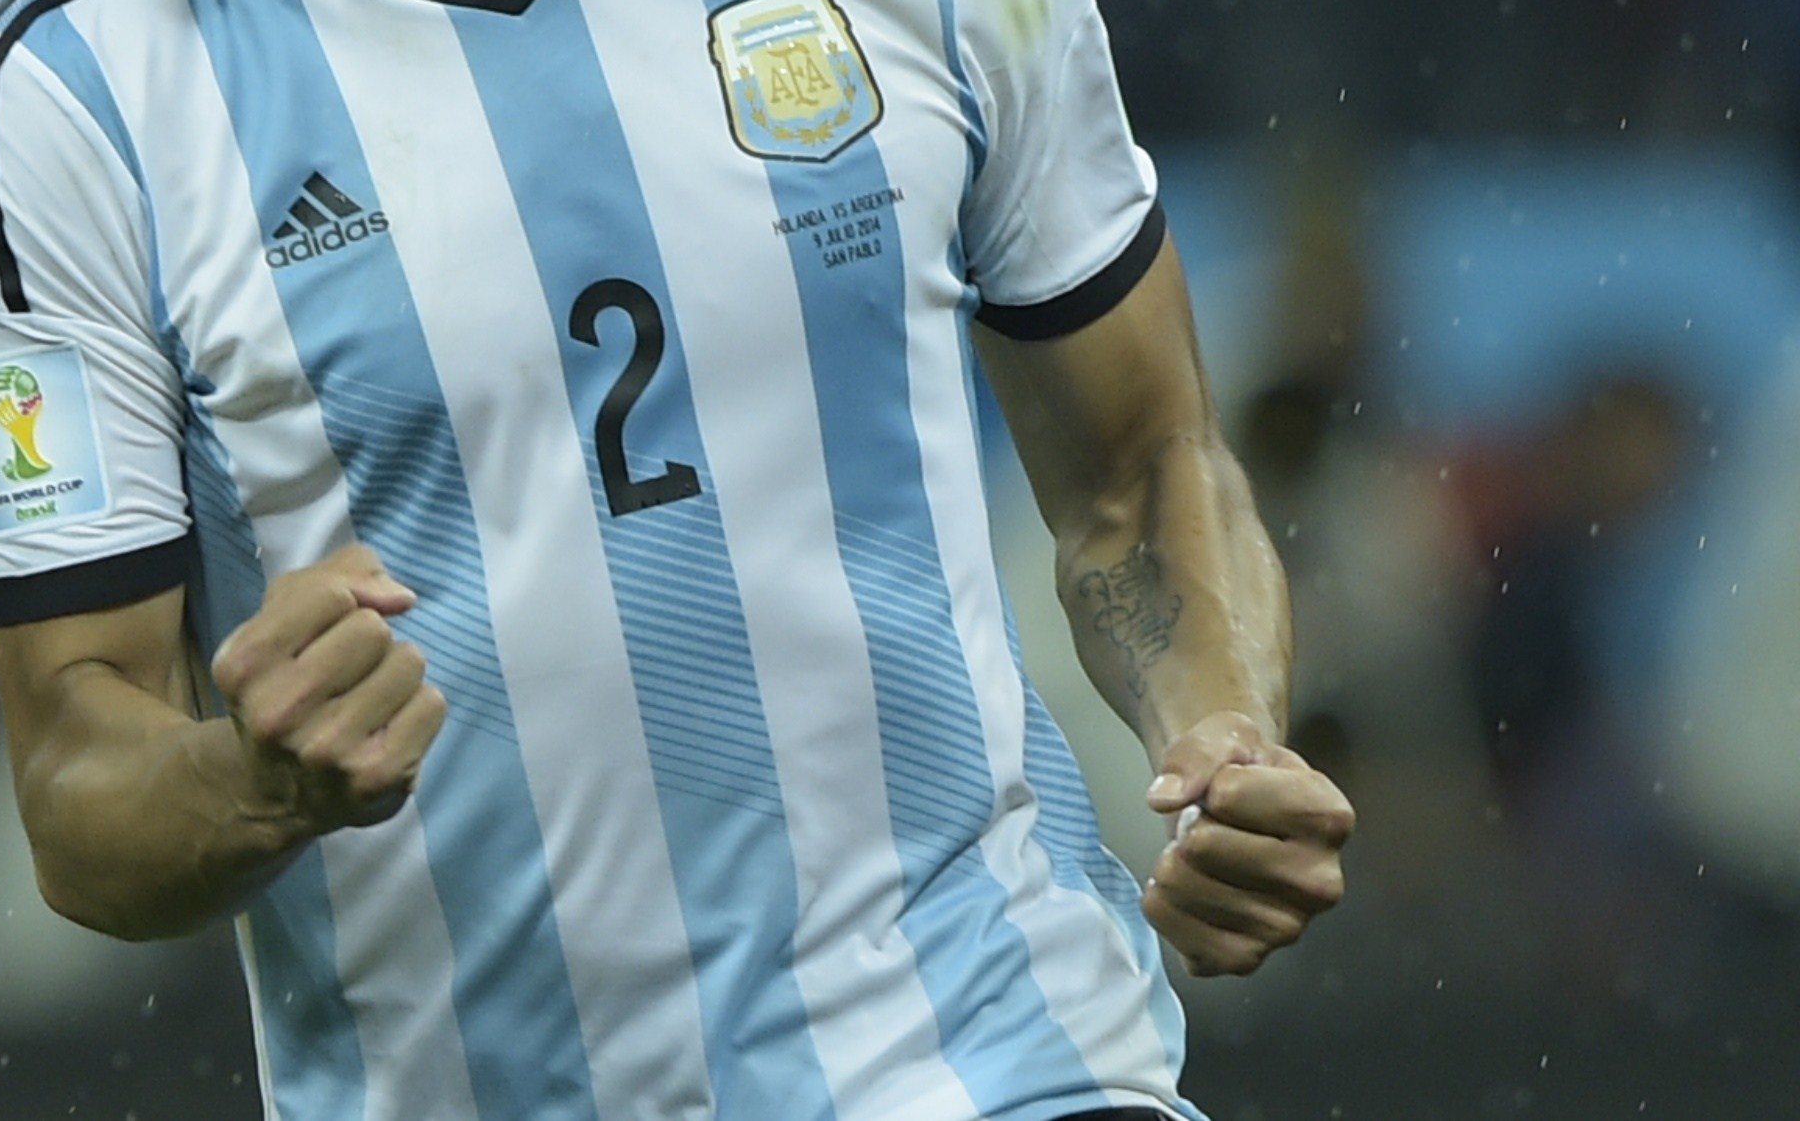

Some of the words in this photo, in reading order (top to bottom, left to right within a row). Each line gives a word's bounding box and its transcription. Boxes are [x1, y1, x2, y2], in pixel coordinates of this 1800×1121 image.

[772, 209, 827, 236] HOLANDA
[831, 201, 849, 220] VS
[850, 187, 905, 214] ARGENTINA
[812, 232, 823, 249] 9
[826, 223, 856, 246] JULIO
[857, 215, 882, 237] 2014
[265, 210, 390, 269] adidas
[823, 249, 848, 269] SAN
[848, 239, 883, 262] PABLO
[569, 277, 703, 517] 2
[12, 484, 57, 502] WORLD
[57, 479, 84, 493] CUP
